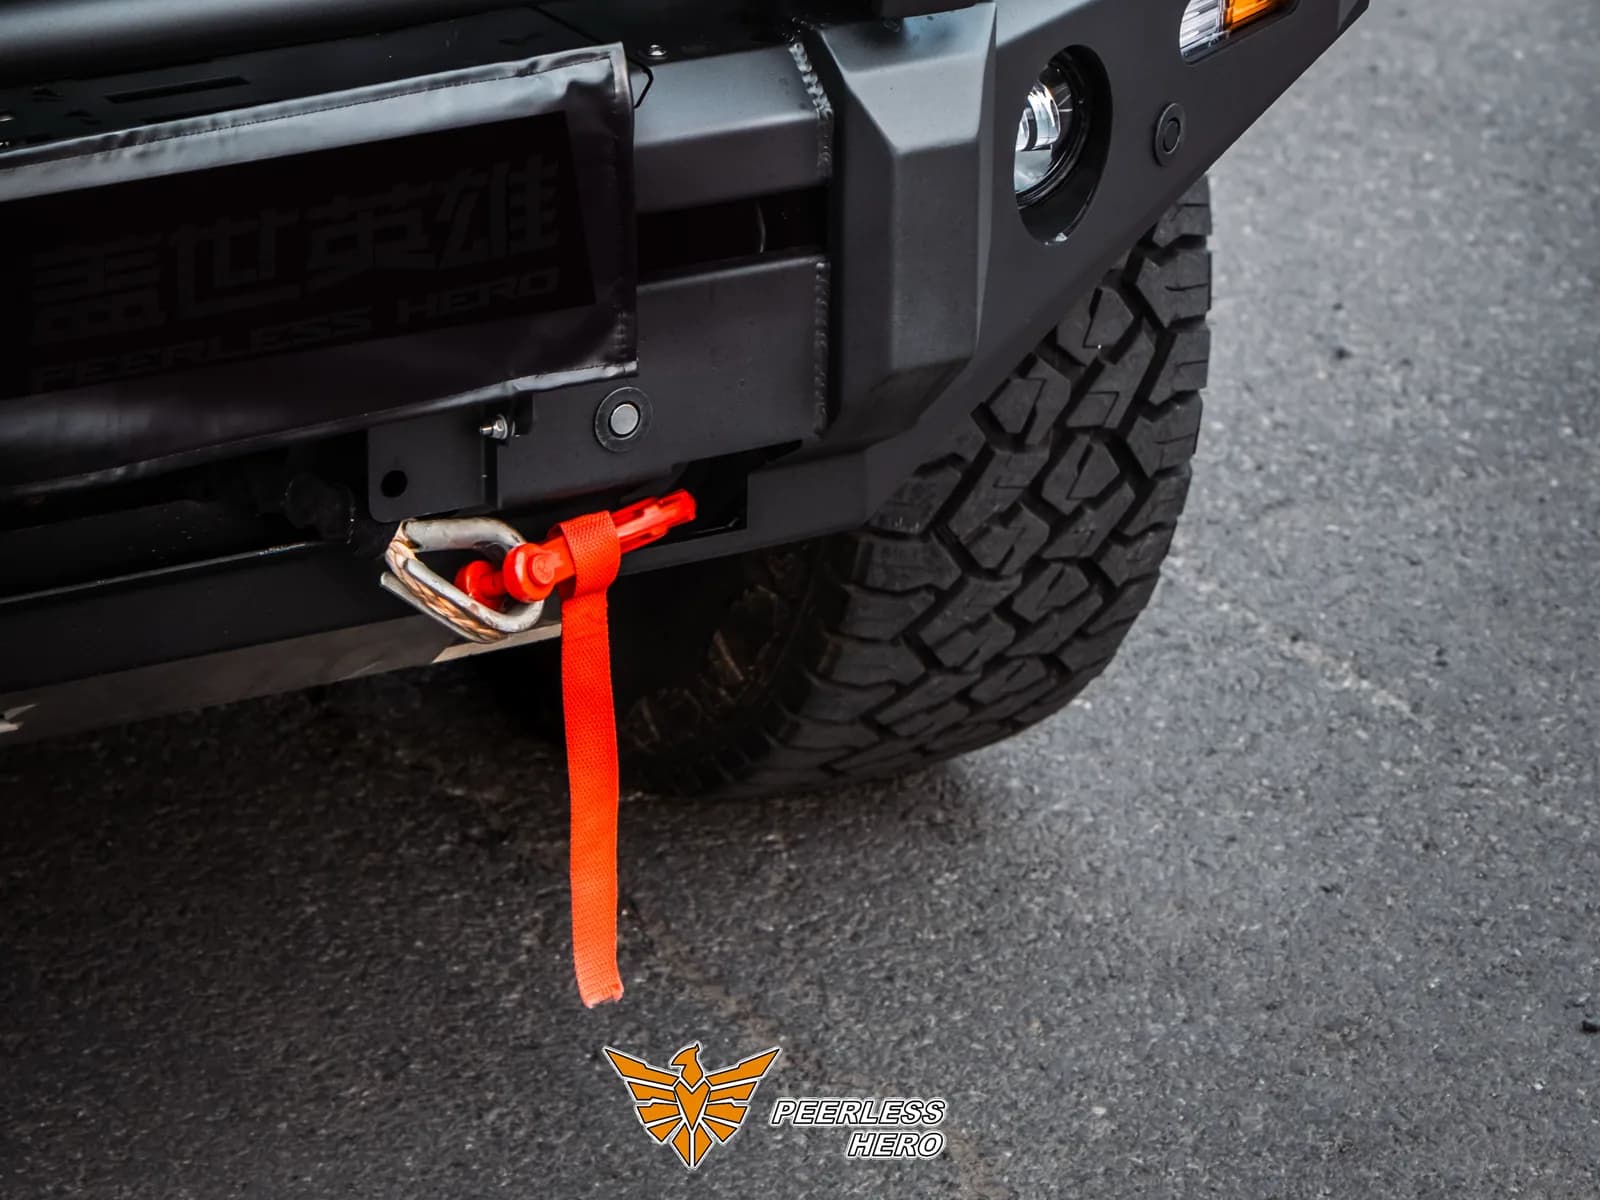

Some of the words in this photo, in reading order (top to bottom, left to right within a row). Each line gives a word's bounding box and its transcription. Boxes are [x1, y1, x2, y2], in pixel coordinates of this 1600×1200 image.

[31, 153, 561, 345] 盖世英雄
[32, 306, 371, 392] PEERLESS
[397, 267, 561, 324] HERO
